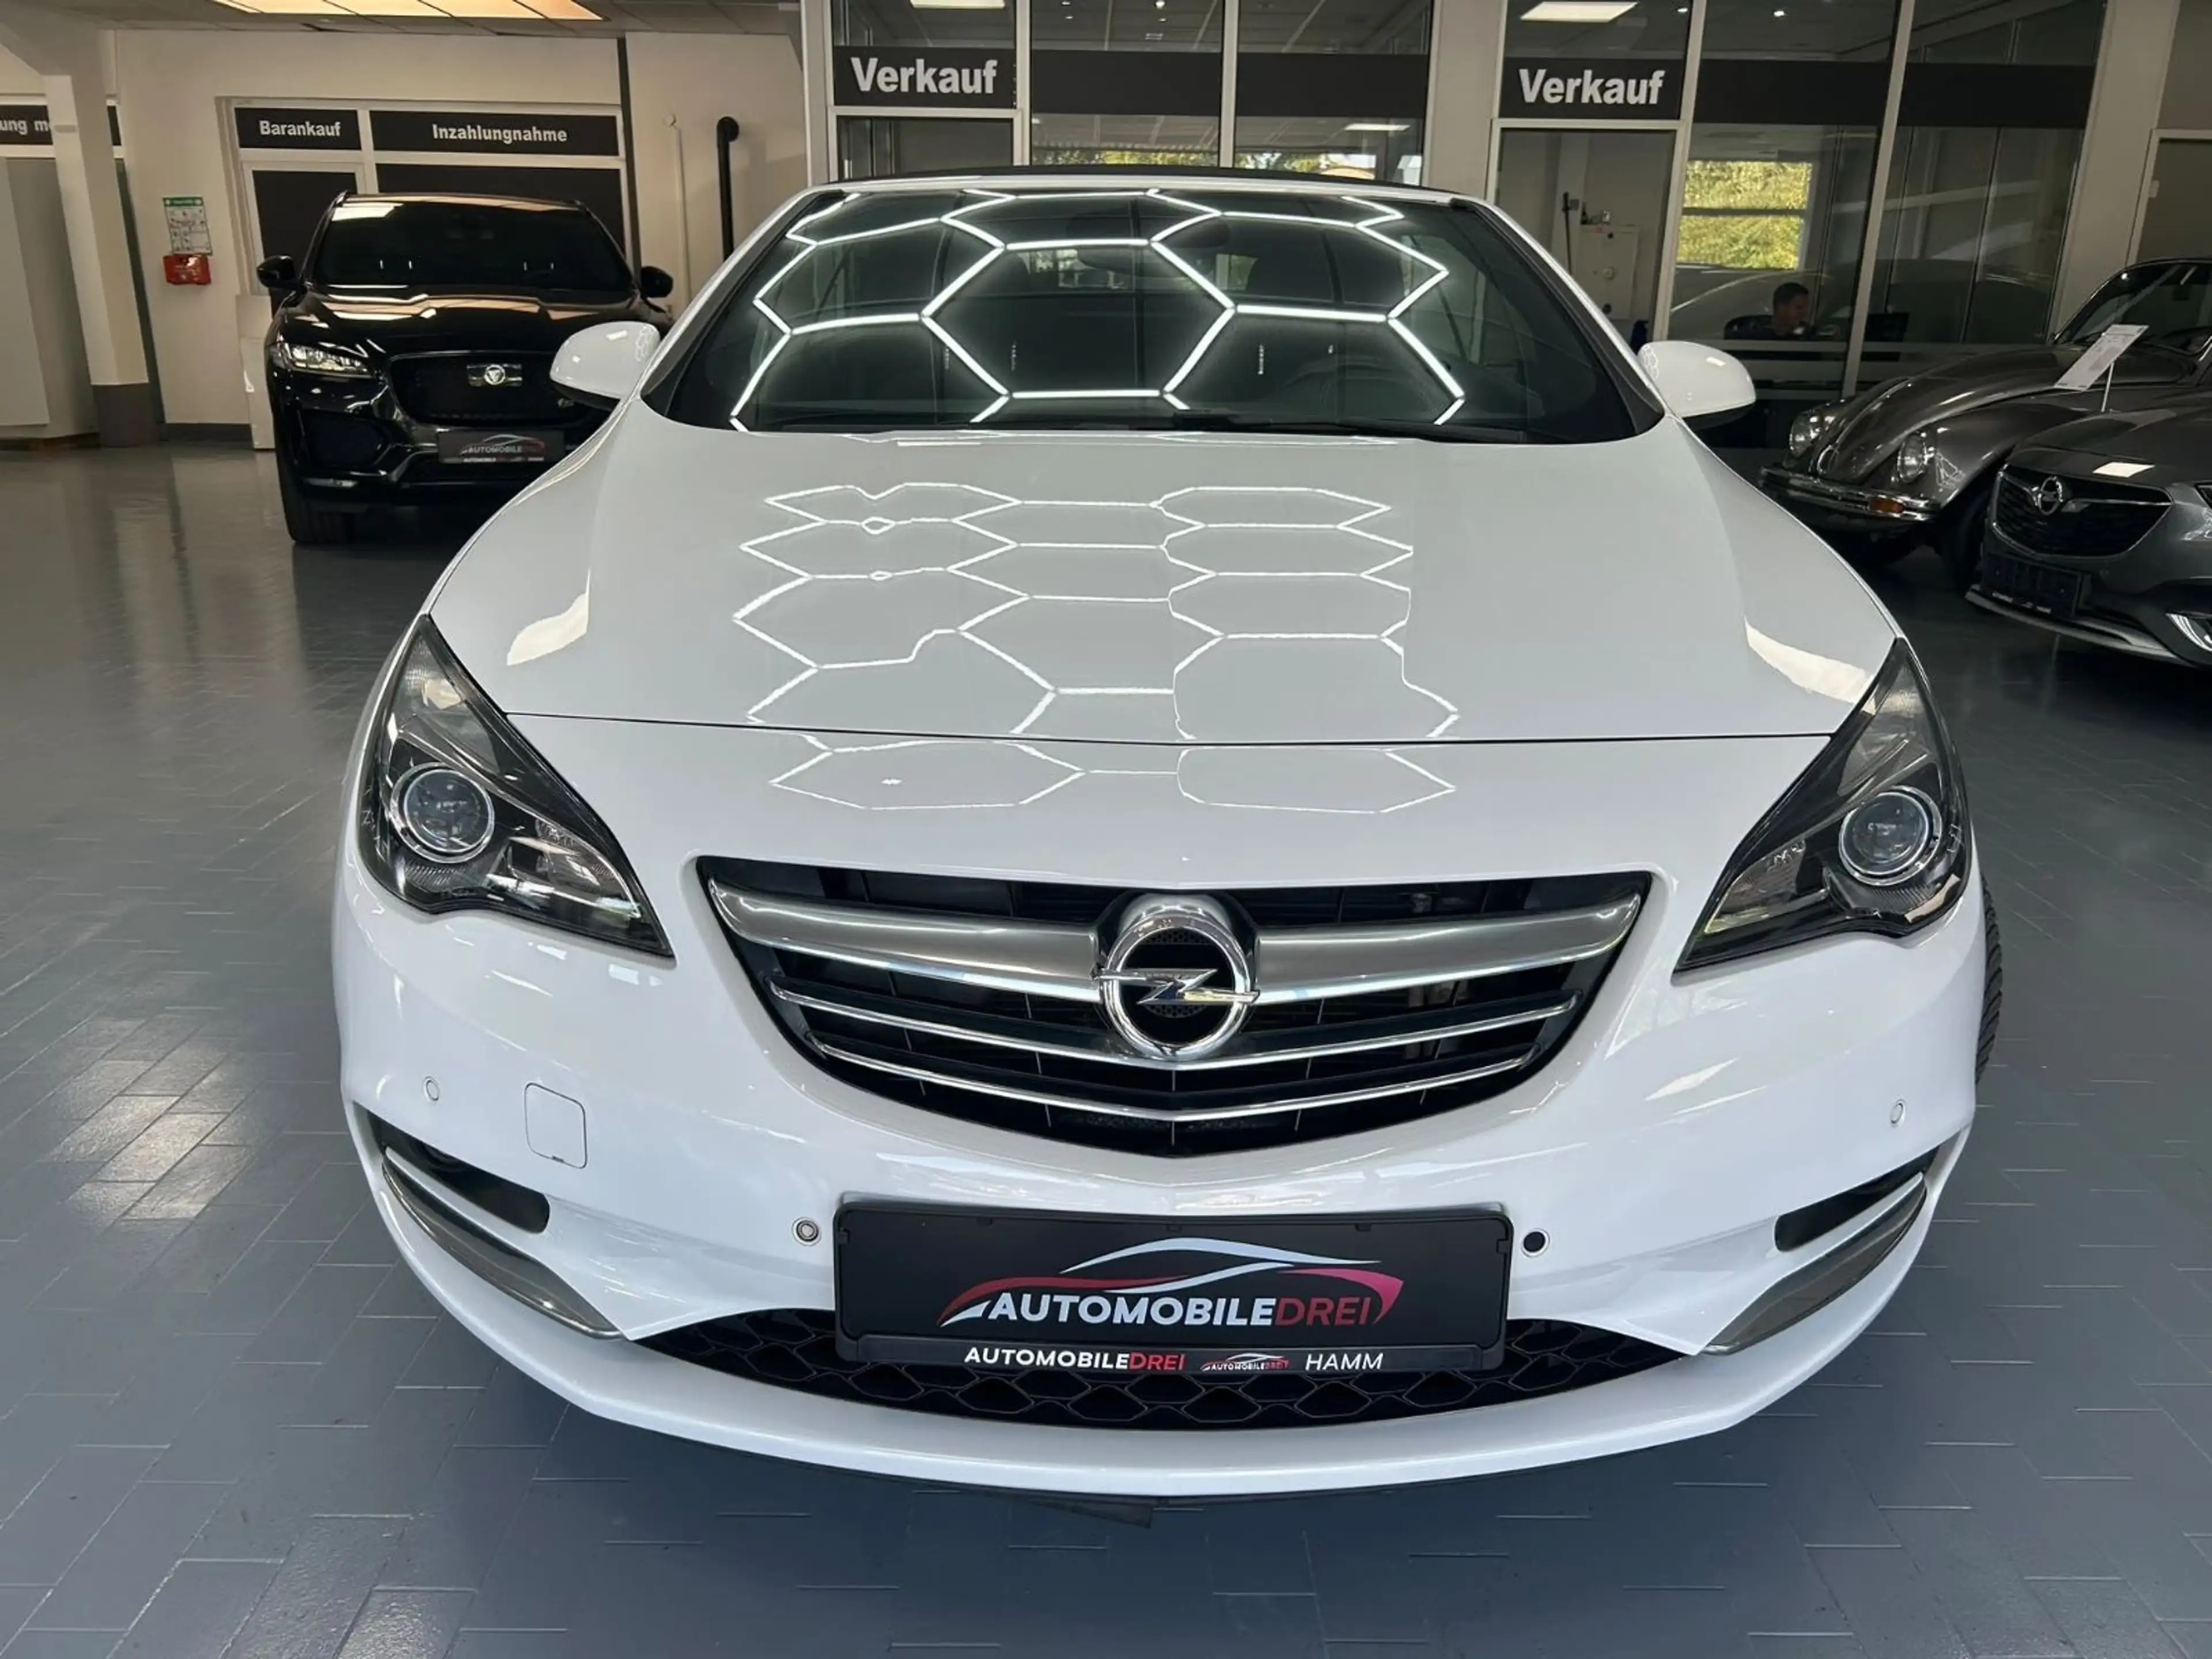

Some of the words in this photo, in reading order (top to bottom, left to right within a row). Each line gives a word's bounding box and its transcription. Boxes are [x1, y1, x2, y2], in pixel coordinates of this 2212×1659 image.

[850, 57, 998, 94] Verkauf
[1518, 68, 1665, 105] Verkauf
[259, 120, 341, 137] Barankauf
[432, 123, 567, 144] Inzahlungnahme
[988, 1292, 1372, 1325] AUTOMOBILEDREI
[964, 1347, 1186, 1370] AUTOMOBILEDREI
[1305, 1353, 1384, 1371] HAMM
